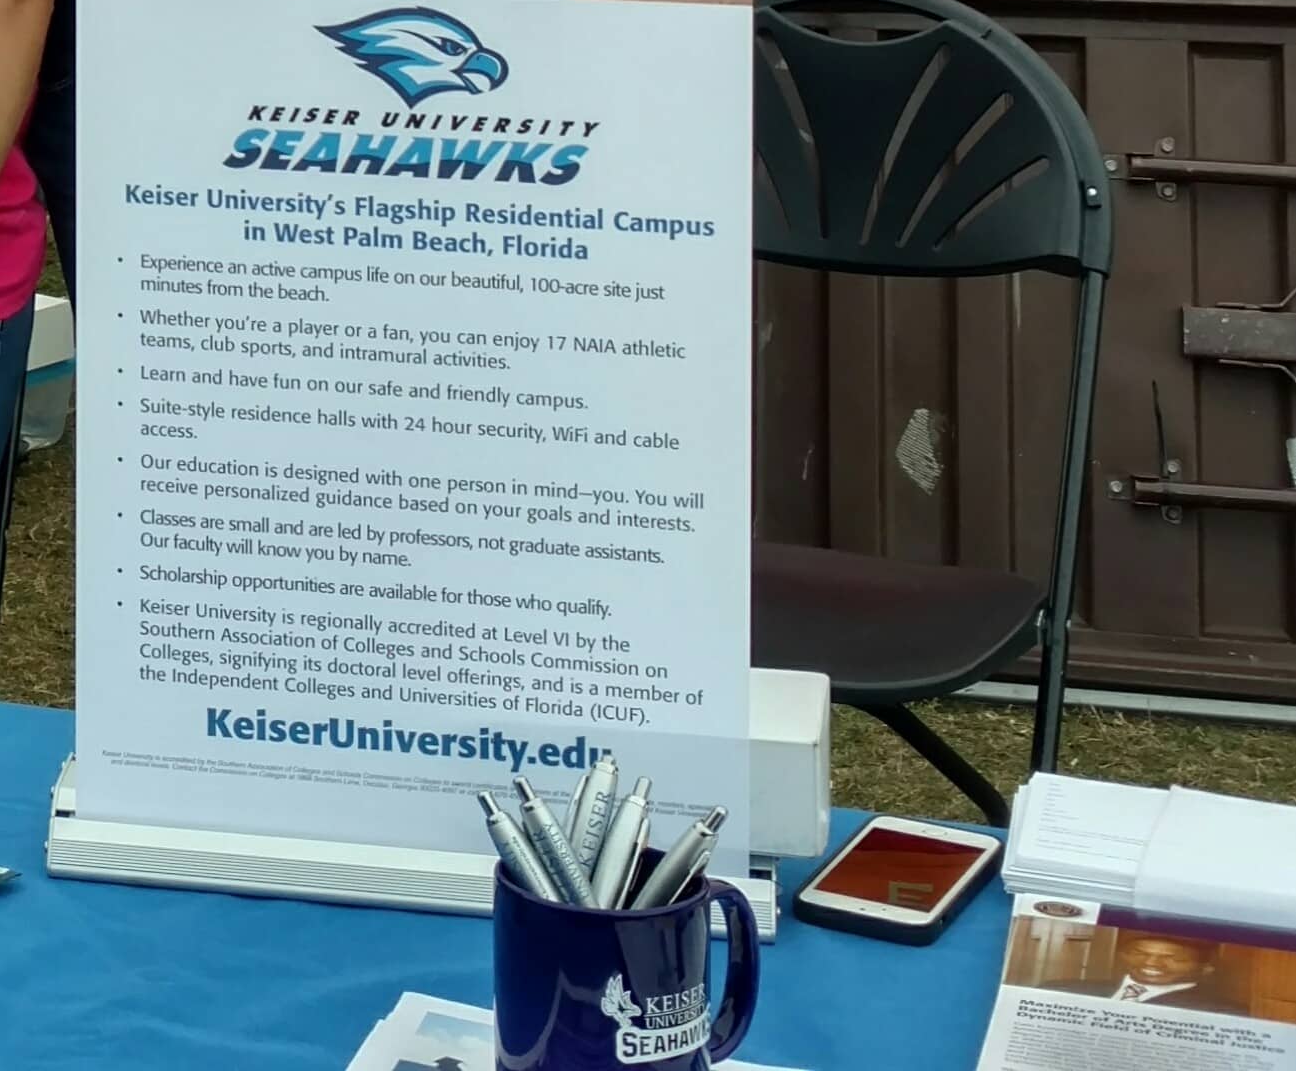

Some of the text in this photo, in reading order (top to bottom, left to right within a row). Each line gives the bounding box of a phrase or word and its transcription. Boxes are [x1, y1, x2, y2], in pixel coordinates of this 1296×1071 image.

[248, 104, 601, 137] KEISER UNIVERSITY
[222, 127, 590, 186] SEAHAWKS
[126, 183, 715, 241] Keiser University's Flagship Residential Campus
[244, 219, 588, 261] in West Palm Beach, Florida
[141, 253, 665, 303] Experience an active campus life on our beautiful, 100-acre site just
[141, 275, 329, 302] minutes from the beach.
[140, 309, 210, 328] Whether
[272, 321, 282, 333] a
[288, 318, 339, 340] player
[345, 325, 362, 338] or
[368, 326, 377, 339] a
[383, 323, 414, 344] fan,
[419, 330, 450, 347] you
[457, 332, 487, 346] can
[493, 334, 540, 353] enjoy
[548, 335, 567, 351] 17
[574, 336, 617, 354] NAIA
[622, 339, 686, 359] athletic
[140, 332, 511, 370] teams, club sports, and intramural activities.
[141, 365, 588, 412] Learn and have fun on our safe and friendly campus.
[140, 397, 679, 450] Suite-style residence halls with 24 hour security, WiFi and cable
[140, 424, 197, 439] access.
[580, 790, 611, 868] KEISER
[646, 983, 707, 1015] KEISER
[621, 1020, 711, 1058] SEAHAW
[1016, 1011, 1086, 1027] Dynamic
[1090, 1020, 1131, 1033] Field
[1135, 1027, 1151, 1035] of
[1156, 1030, 1226, 1047] Criminal
[1018, 1005, 1087, 1020] Bachelor
[1094, 1015, 1111, 1023] of
[1114, 1018, 1148, 1029] Arts
[1158, 1025, 1210, 1040] Degree
[1103, 1009, 1138, 1021] Your
[1220, 1026, 1257, 1037] with
